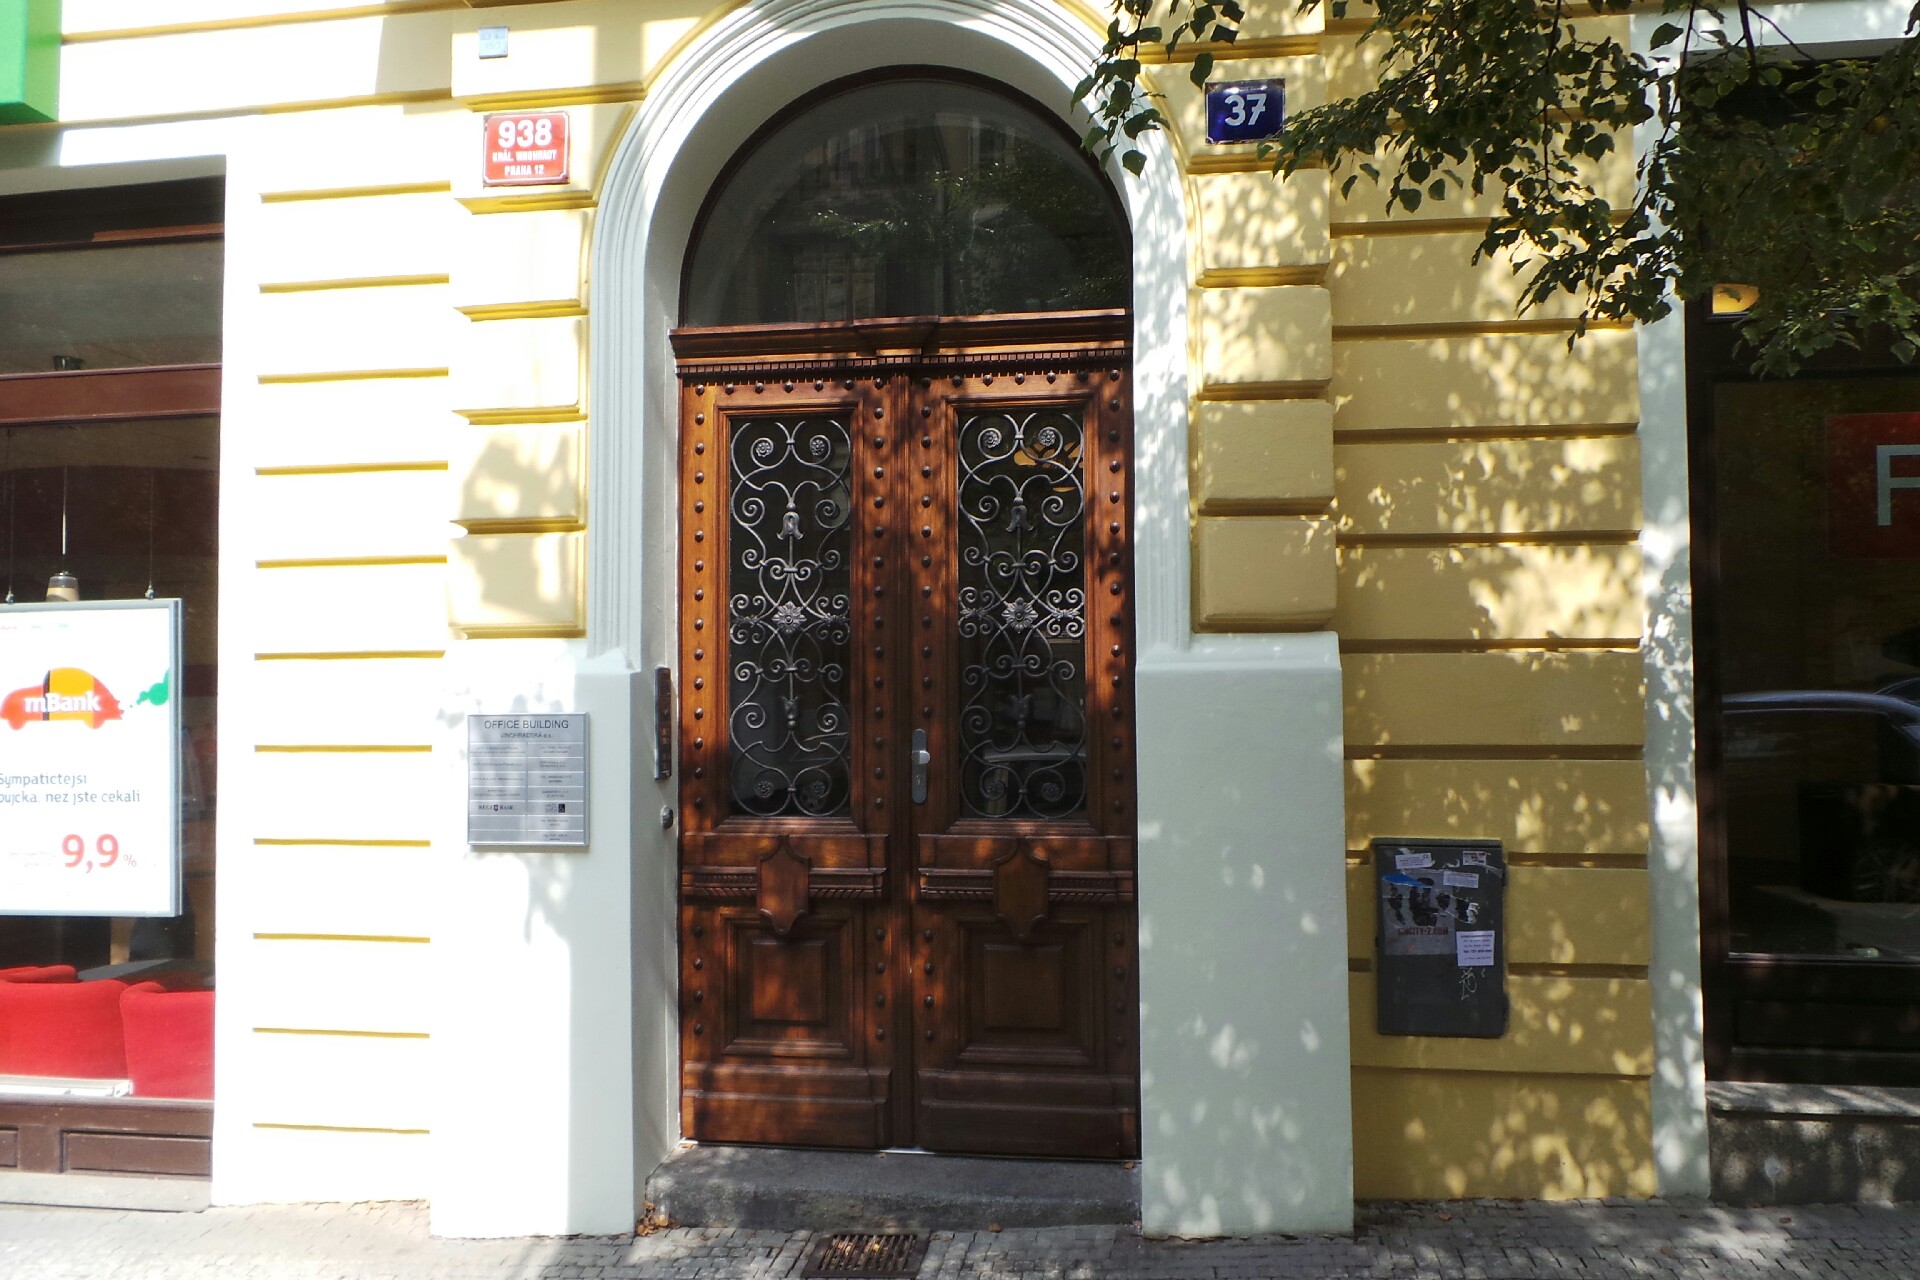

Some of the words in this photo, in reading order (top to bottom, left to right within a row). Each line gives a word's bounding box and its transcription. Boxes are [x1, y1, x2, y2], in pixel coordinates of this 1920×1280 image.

[1224, 93, 1267, 126] 37
[497, 118, 552, 148] 938
[504, 165, 532, 176] PRAHA
[534, 164, 545, 175] 12
[24, 691, 101, 713] mBank
[484, 720, 520, 729] OFFICE
[522, 719, 569, 729] BUILDING
